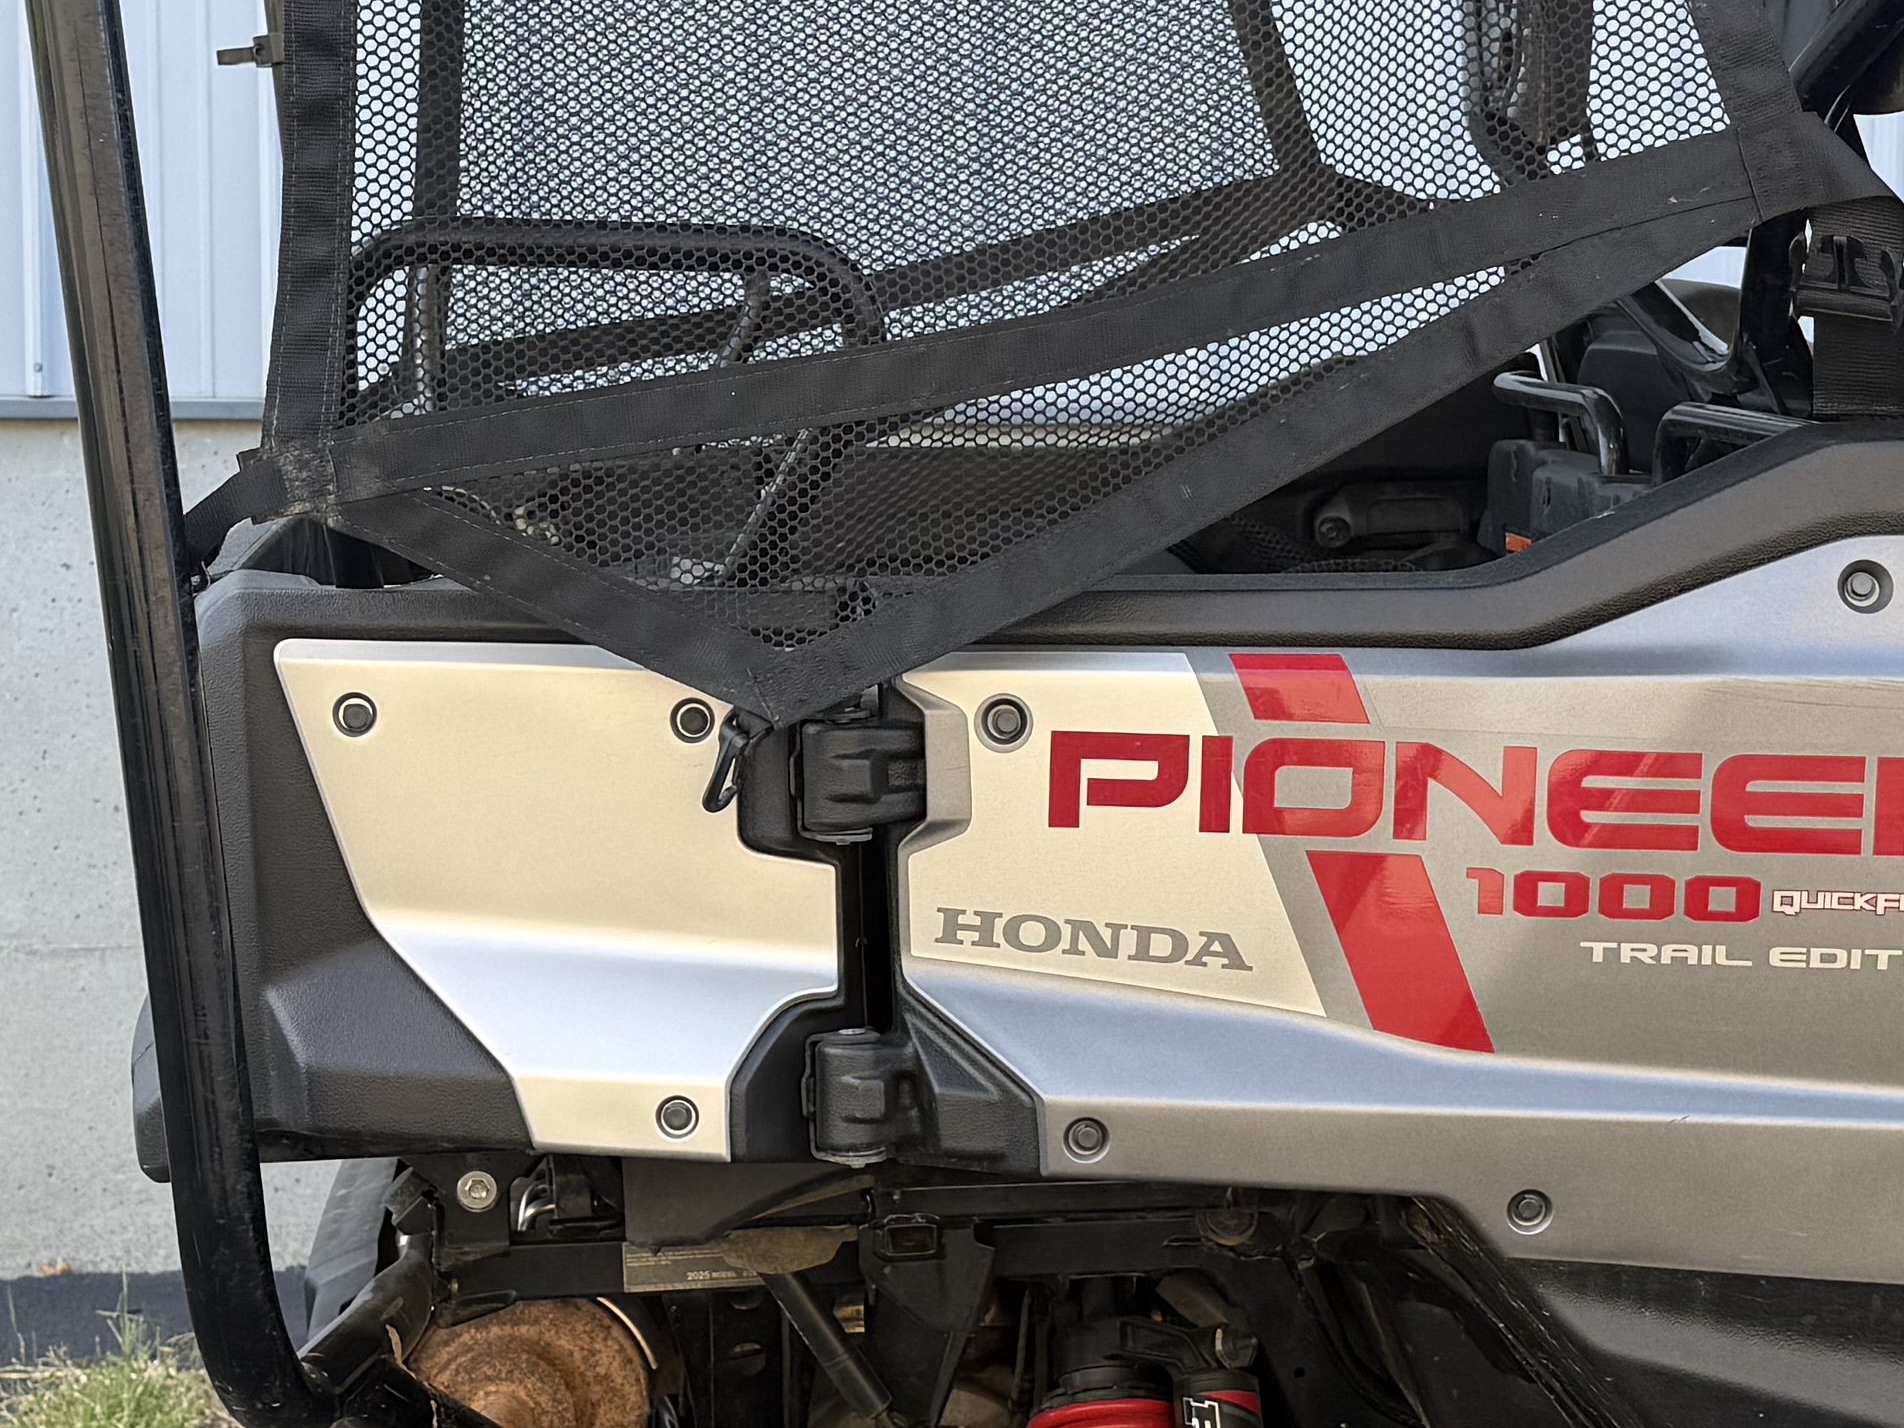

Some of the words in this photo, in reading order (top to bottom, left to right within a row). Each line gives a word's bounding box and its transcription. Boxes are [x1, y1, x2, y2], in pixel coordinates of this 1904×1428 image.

[1467, 867, 1762, 923] 1000
[934, 908, 1253, 973] HONDA
[1580, 941, 1753, 968] TRAIL
[686, 1271, 711, 1281] 2025
